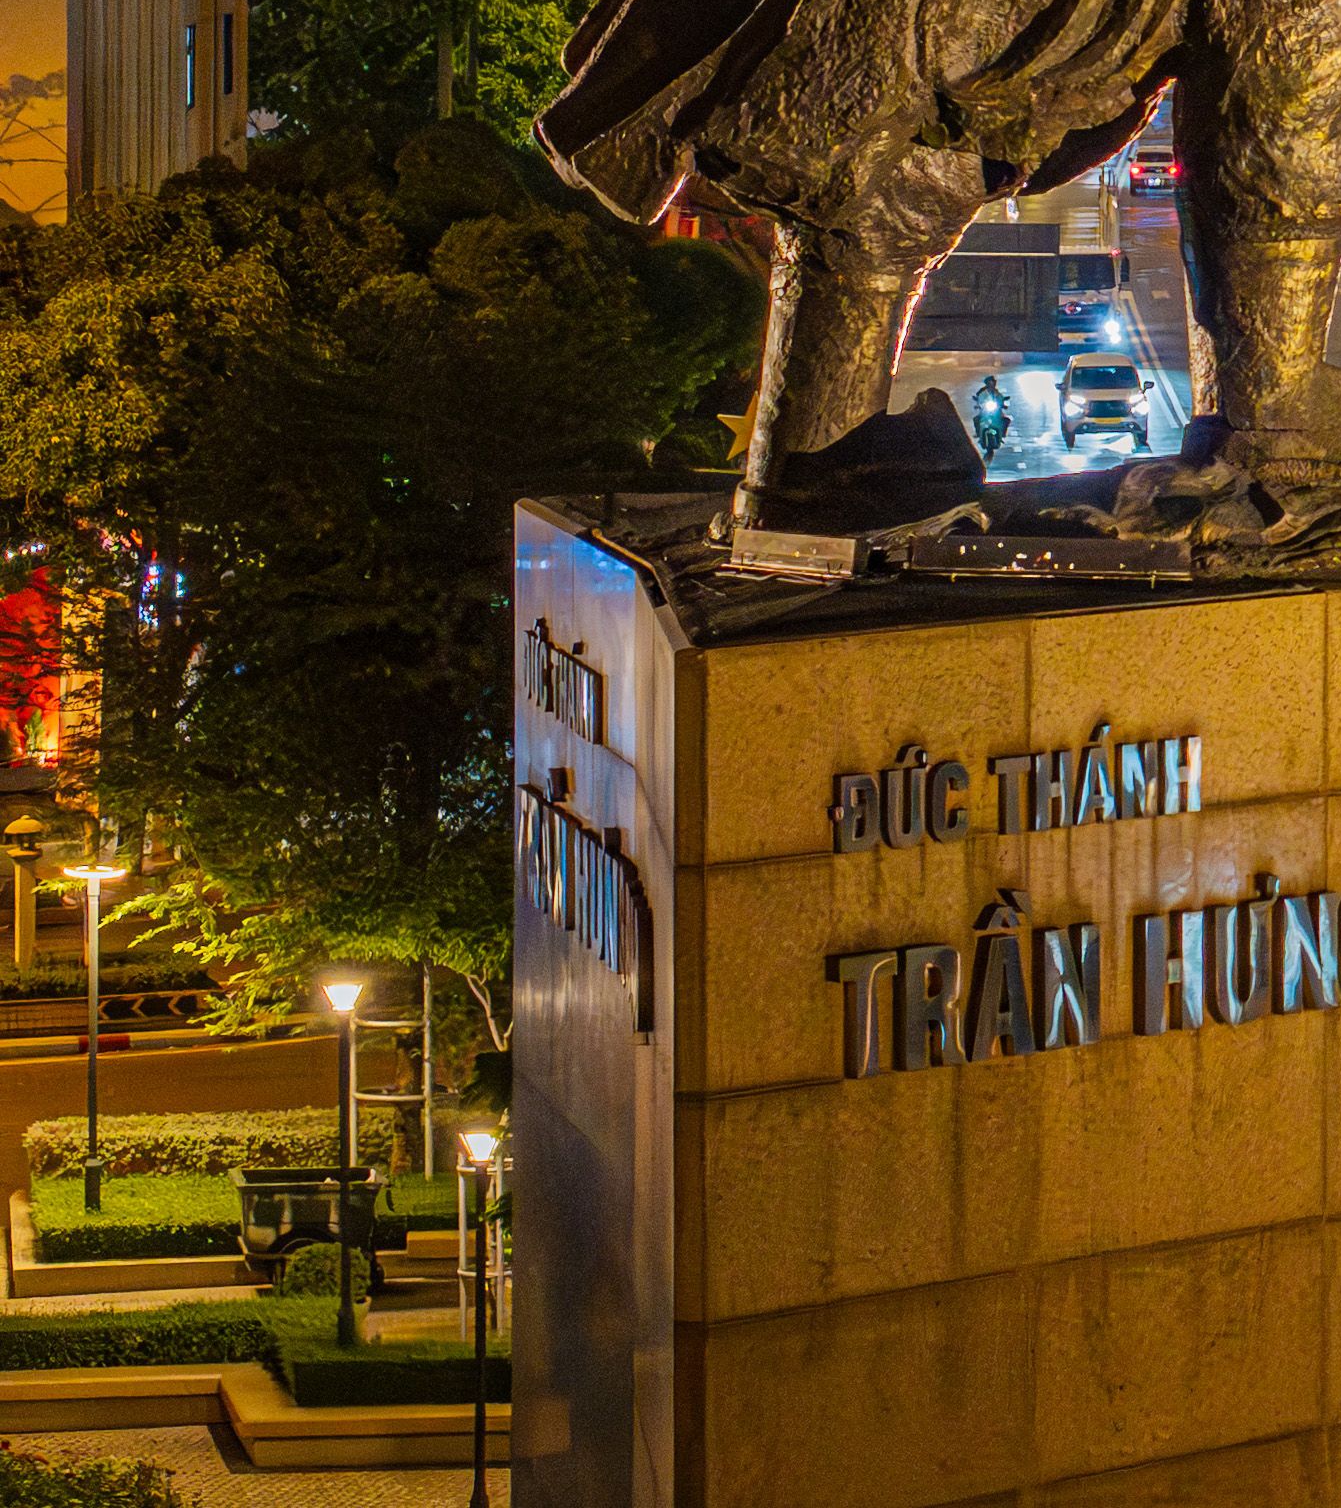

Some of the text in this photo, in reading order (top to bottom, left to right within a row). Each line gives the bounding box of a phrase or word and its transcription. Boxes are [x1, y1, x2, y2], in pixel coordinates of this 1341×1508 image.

[827, 723, 1203, 854] ĐỨC THÁNH
[825, 887, 1101, 1079] TRẦN
